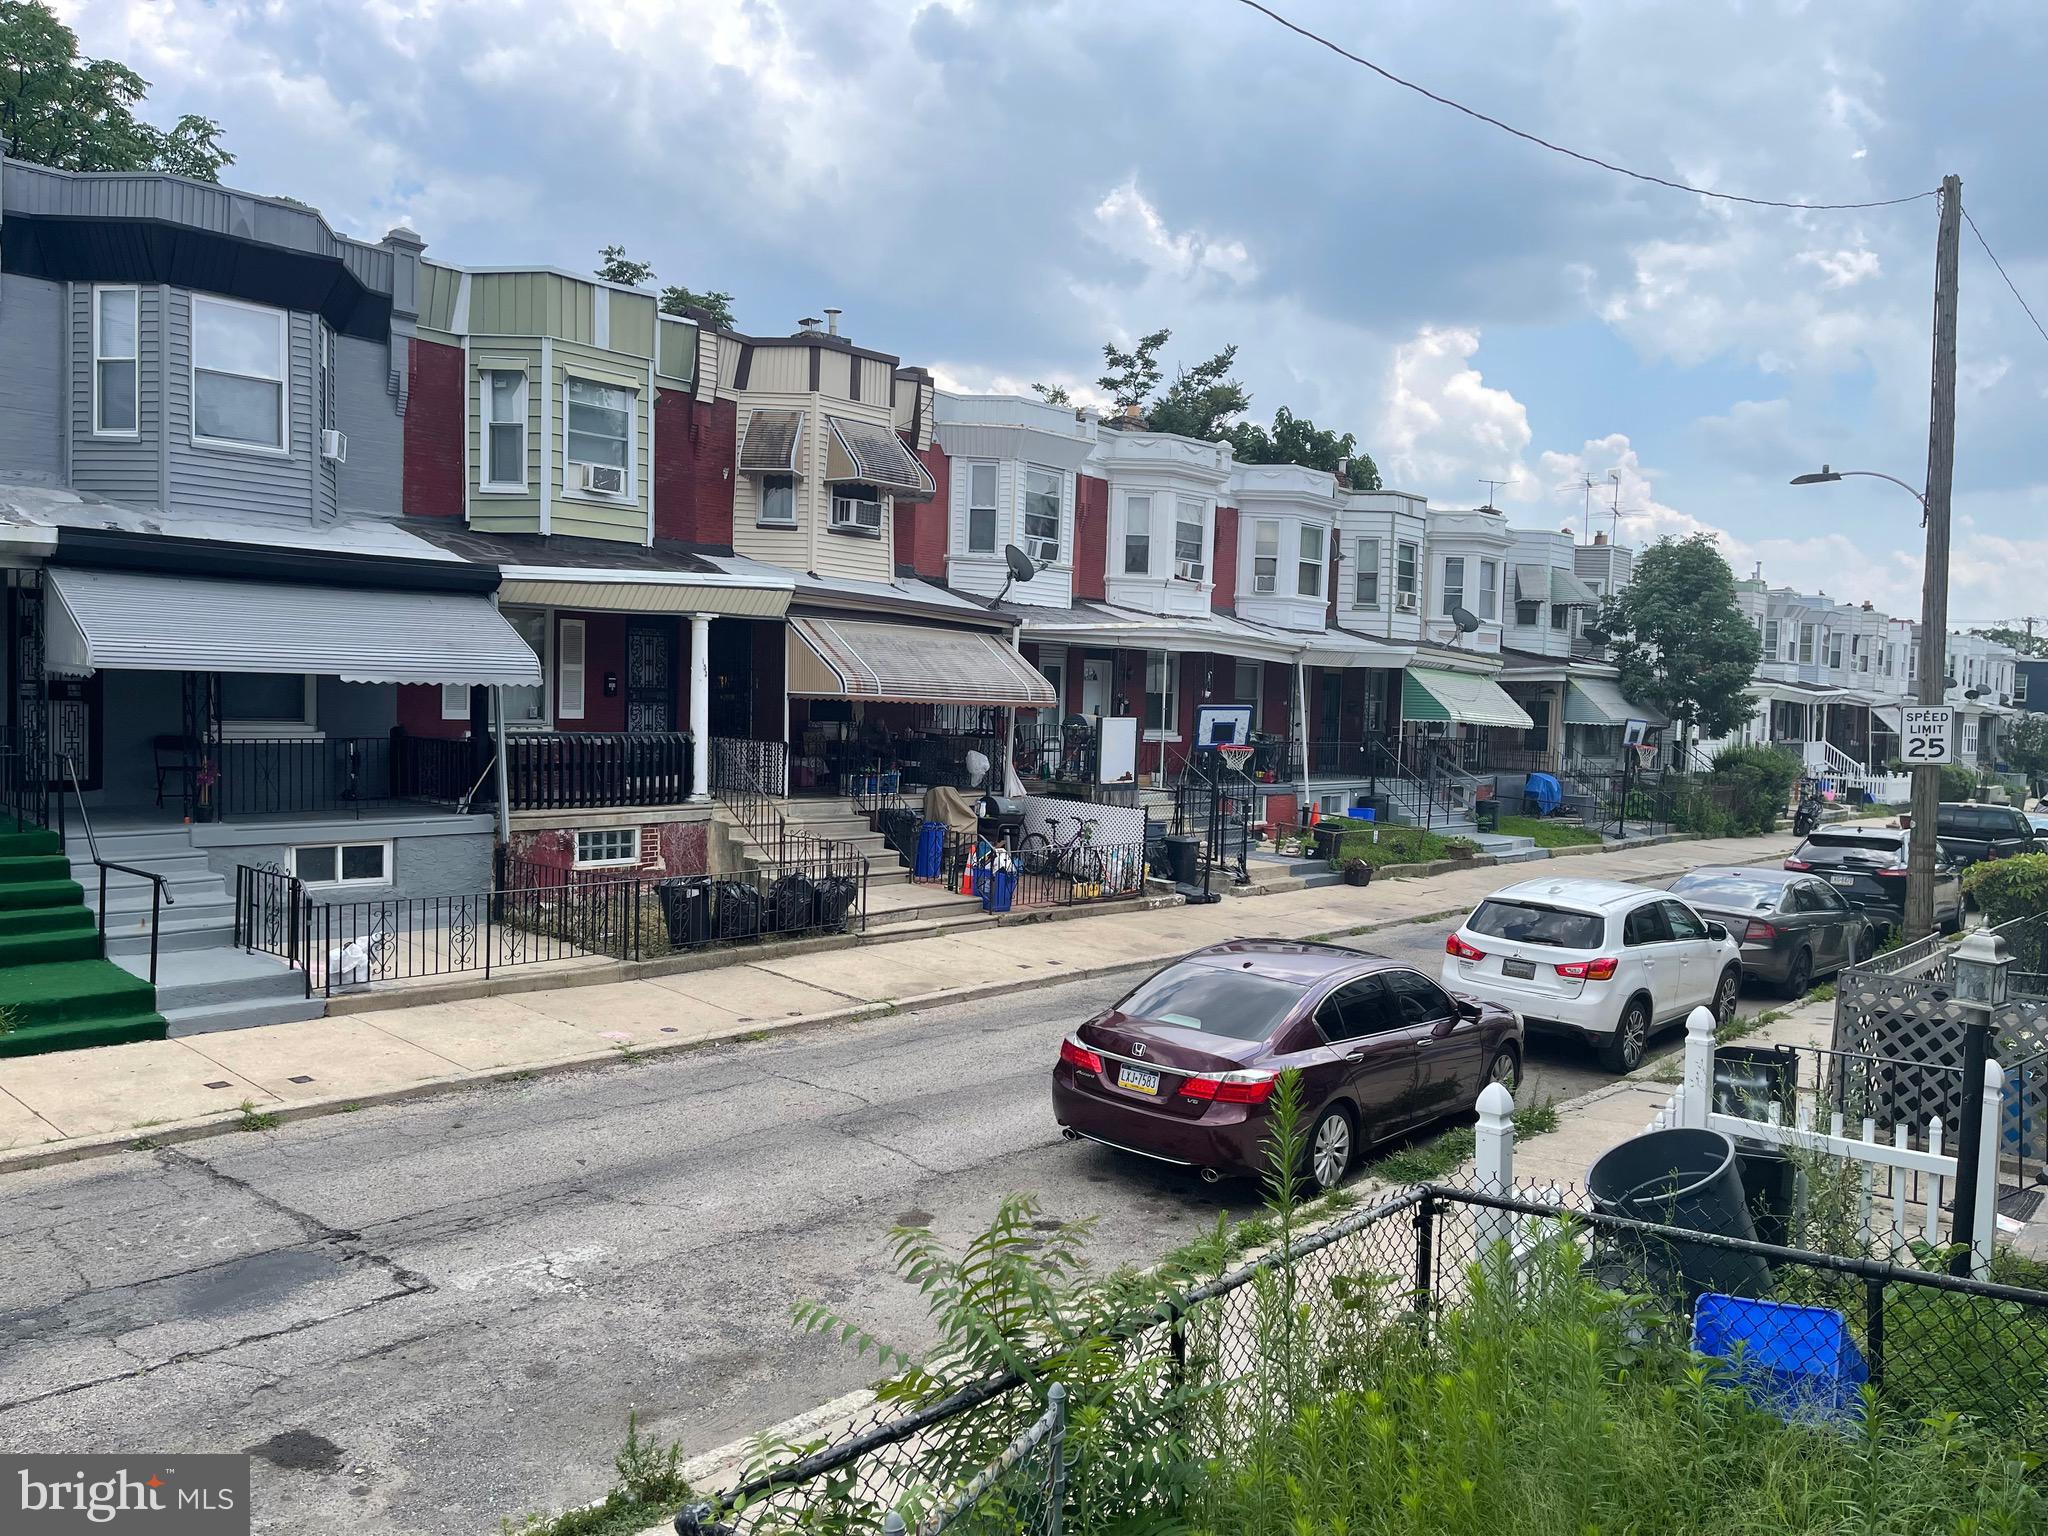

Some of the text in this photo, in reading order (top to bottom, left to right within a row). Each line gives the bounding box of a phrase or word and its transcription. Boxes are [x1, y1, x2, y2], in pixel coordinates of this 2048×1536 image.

[1906, 712, 1949, 722] SPEED
[1910, 725, 1944, 734] LIMIT
[1908, 737, 1945, 758] 25
